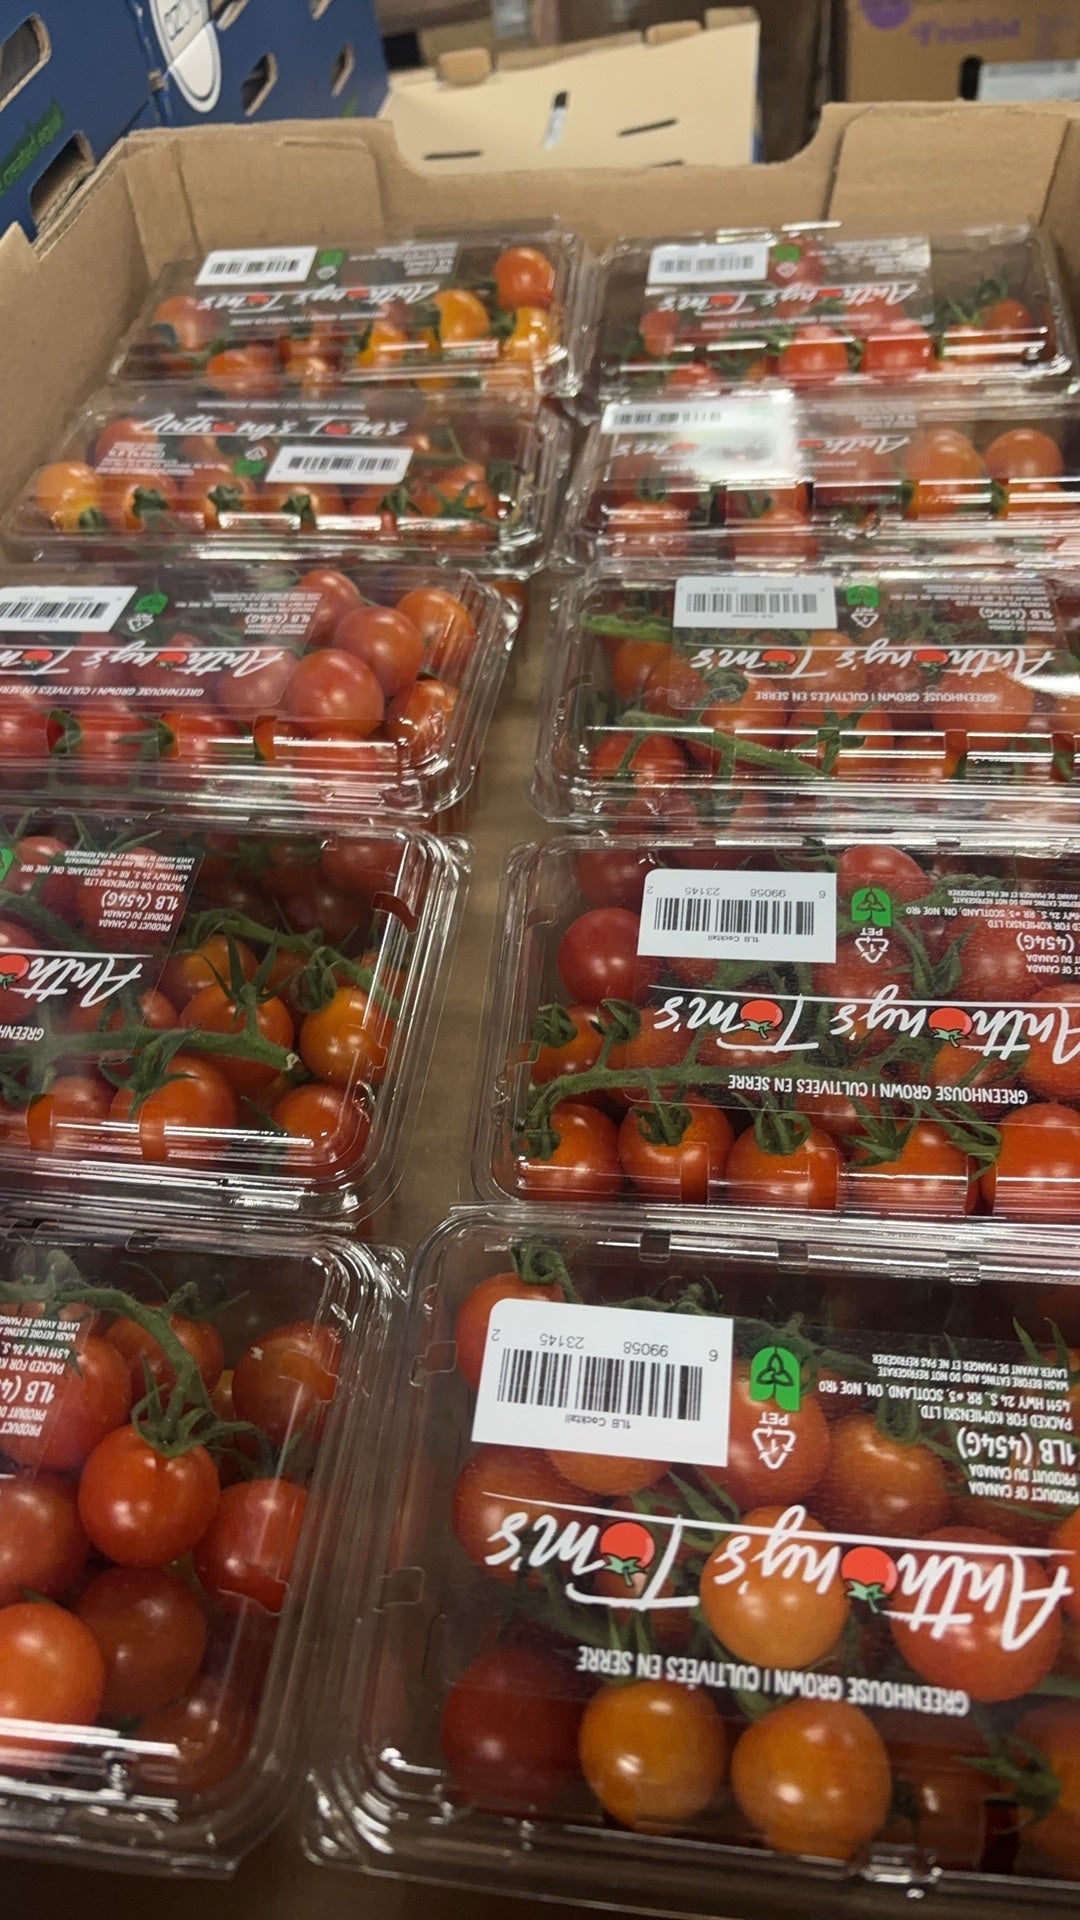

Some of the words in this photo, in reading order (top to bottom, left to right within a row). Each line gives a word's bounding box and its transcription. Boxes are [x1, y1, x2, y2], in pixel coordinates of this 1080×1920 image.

[754, 691, 789, 700] SERRE
[792, 692, 807, 701] EN
[877, 692, 920, 702] GROWN
[140, 882, 155, 890] FOR
[156, 882, 185, 892] PACKED
[646, 886, 653, 894] 2
[684, 887, 720, 896] 23145
[750, 888, 786, 897] 99058
[100, 890, 152, 910] (454G)
[819, 890, 826, 898] 6
[155, 895, 179, 911] 1LB
[103, 909, 132, 918] CANADA
[133, 911, 142, 920] DU
[144, 912, 174, 922] PRODUIT
[959, 907, 1005, 918] SCOTLAND,
[1023, 910, 1035, 918] RR
[98, 919, 127, 928] CANADA
[128, 921, 137, 930] OF
[140, 922, 171, 932] PRODUCT
[1005, 920, 1051, 930] KOMIENSKI
[1053, 922, 1070, 930] FOR
[708, 934, 740, 942] Cocktail
[860, 927, 883, 936] PET
[1016, 932, 1074, 954] (454G)
[1026, 954, 1059, 963] CANADA
[1061, 955, 1072, 964] DU
[1026, 964, 1059, 974] CANADA
[1061, 966, 1072, 974] OF
[728, 1074, 771, 1090] SERRE
[774, 1077, 792, 1092] EN
[796, 1078, 868, 1098] CULTIVÉES
[880, 1083, 932, 1100] GROWN
[935, 1086, 1028, 1104] GREENHOUSE
[58, 1321, 80, 1331] LAVER
[55, 1332, 76, 1341] WASH
[490, 1329, 500, 1342] 2
[539, 1332, 584, 1349] 23145
[12, 1344, 25, 1356] 24
[26, 1345, 49, 1358] HWY
[623, 1340, 669, 1358] 99058
[708, 1349, 718, 1362] 6
[9, 1359, 28, 1371] FOR
[30, 1360, 65, 1374] PACKED
[921, 1357, 936, 1367] PAS
[938, 1358, 949, 1370] NE
[952, 1360, 961, 1371] ET
[963, 1360, 997, 1373] MANGER
[999, 1363, 1009, 1374] DE
[878, 1366, 929, 1380] REFRIGERATE
[931, 1370, 947, 1382] NOT
[1011, 1364, 1038, 1376] AVANT
[1040, 1367, 1067, 1378] LAVER
[949, 1372, 961, 1383] DO
[963, 1373, 980, 1385] AND
[981, 1374, 1010, 1387] EATING
[1012, 1376, 1042, 1389] BEFORE
[864, 1382, 884, 1397] ON,
[1044, 1379, 1068, 1391] WASH
[24, 1380, 55, 1404] 1LB
[885, 1384, 944, 1402] SCOTLAND,
[967, 1391, 982, 1405] RR
[1000, 1394, 1015, 1407] 24
[1018, 1396, 1044, 1410] HWY
[1046, 1399, 1070, 1412] 4511
[7, 1406, 47, 1421] PRODUIT
[918, 1404, 941, 1419] LTD.
[943, 1406, 1003, 1425] KOMIENSKI
[565, 1413, 606, 1427] Cocktail
[612, 1419, 631, 1429] 1LB
[758, 1411, 789, 1426] PET
[1005, 1411, 1028, 1426] FOR
[1030, 1414, 1072, 1431] PACKED
[0, 1422, 42, 1437] PRODUCT
[956, 1426, 1033, 1465] (454G)
[1038, 1438, 1076, 1466] 1LB
[968, 1463, 1012, 1480] CANADA
[1014, 1468, 1029, 1482] DU
[1032, 1470, 1078, 1487] PRODUIT
[968, 1481, 1012, 1498] CANADA
[1014, 1486, 1029, 1500] OF
[1032, 1486, 1080, 1505] PRODUCT
[577, 1646, 633, 1676] SERRE
[638, 1652, 662, 1680] EN
[665, 1654, 759, 1692] CULTIVÉES
[774, 1669, 842, 1700] GROWN
[845, 1677, 970, 1717] GREENHOUSE
